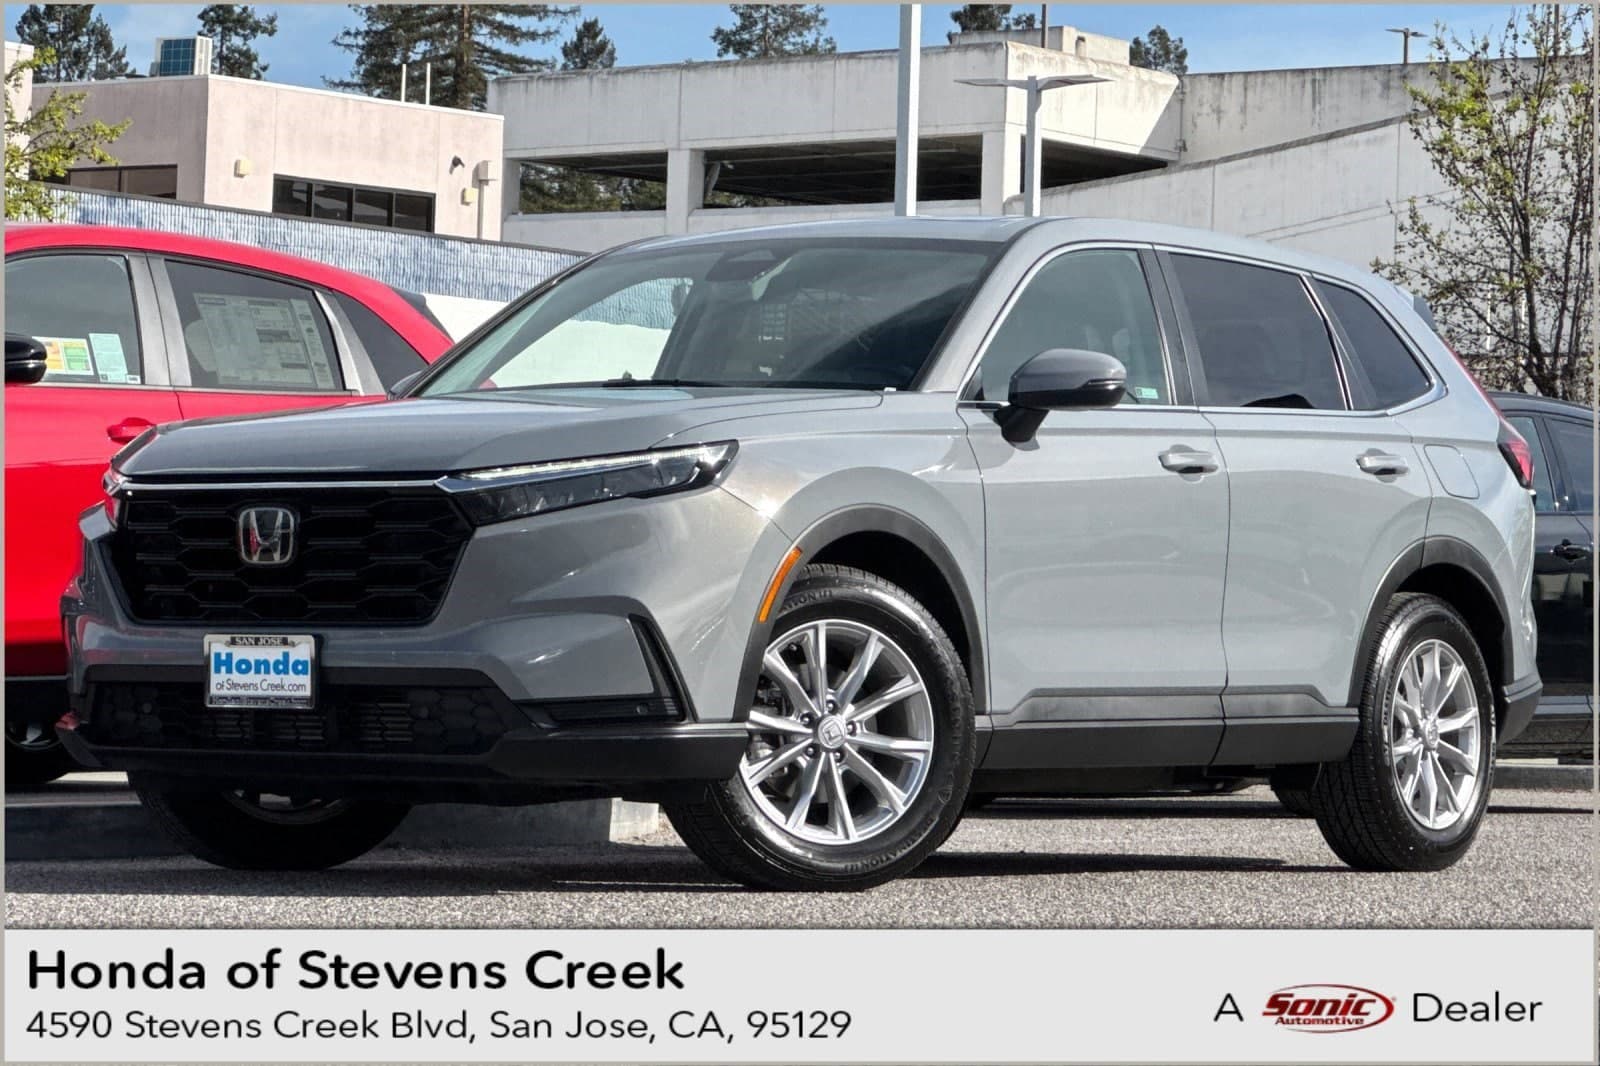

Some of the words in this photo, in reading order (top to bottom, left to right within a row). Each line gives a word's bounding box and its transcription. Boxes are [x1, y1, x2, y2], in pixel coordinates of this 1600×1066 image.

[235, 636, 256, 646] SAN
[258, 637, 284, 646] JOSE
[213, 651, 310, 676] Honda
[215, 679, 225, 691] of
[225, 678, 259, 691] Stevens
[259, 678, 307, 692] Creek.com
